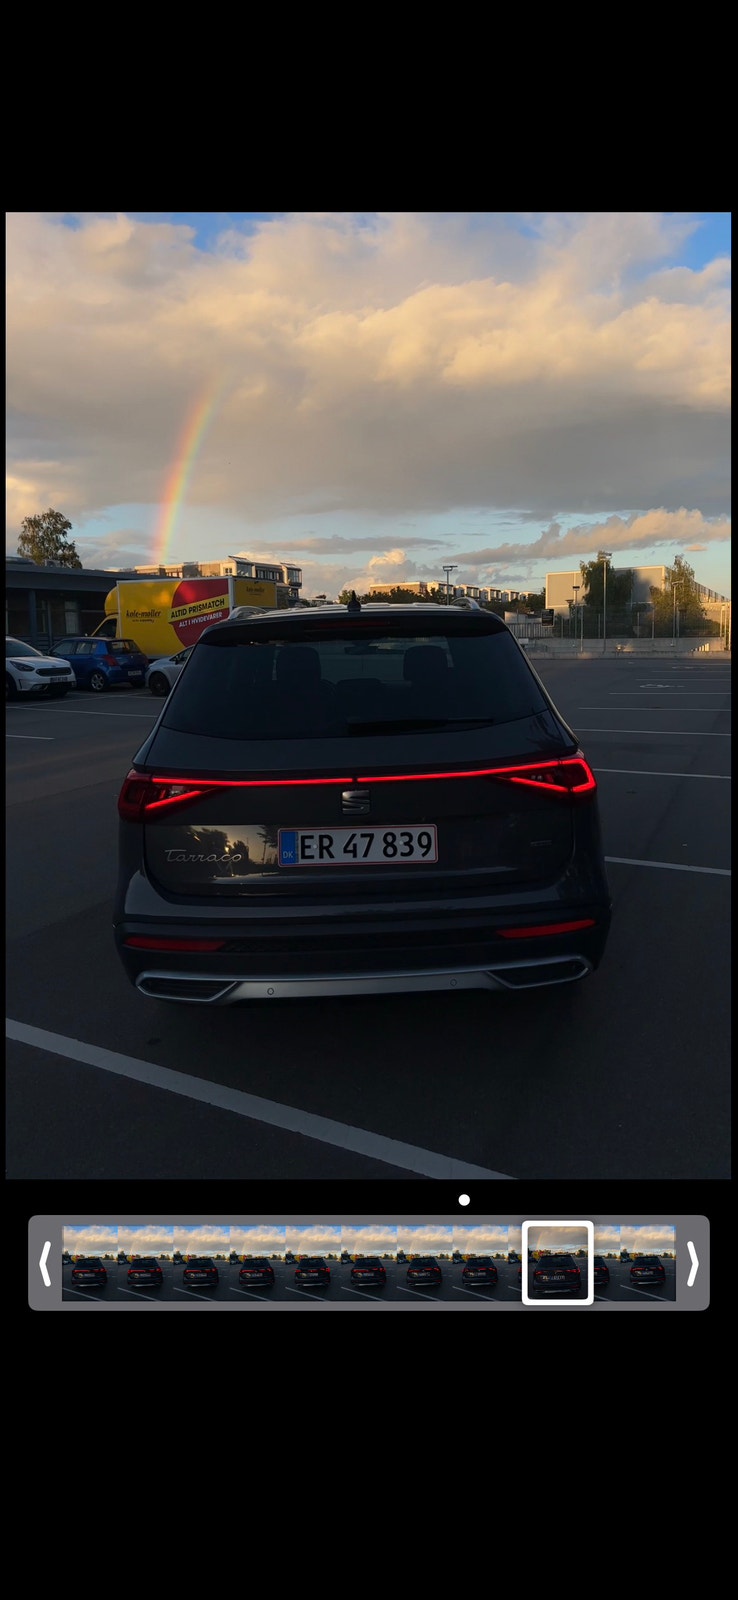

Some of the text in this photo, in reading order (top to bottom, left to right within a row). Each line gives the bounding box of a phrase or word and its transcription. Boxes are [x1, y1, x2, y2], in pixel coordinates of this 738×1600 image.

[171, 598, 225, 619] ALTID PRISMATCH
[179, 620, 188, 628] ALT
[191, 611, 223, 625] HVIDEVARER
[300, 831, 433, 860] ER 47 839
[164, 848, 242, 863] Tarraco
[282, 850, 294, 859] DK
